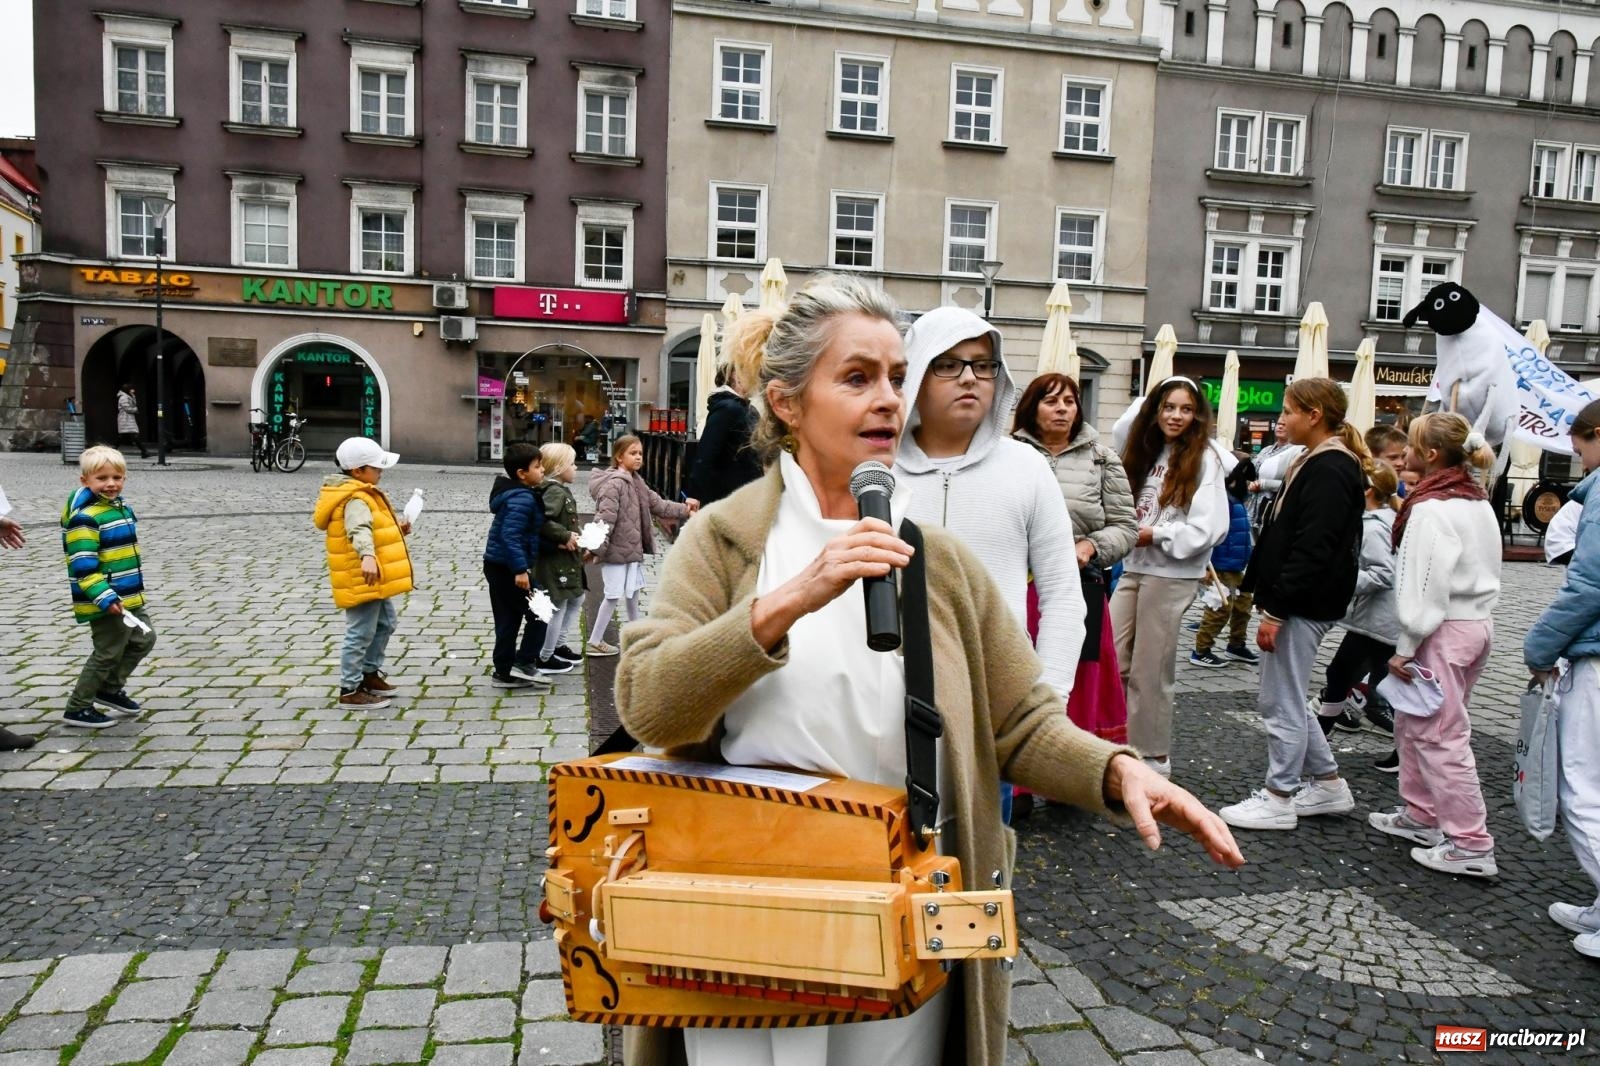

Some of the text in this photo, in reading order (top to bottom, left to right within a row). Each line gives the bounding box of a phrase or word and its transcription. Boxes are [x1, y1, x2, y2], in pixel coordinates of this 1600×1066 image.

[80, 268, 192, 287] TABAC
[242, 276, 394, 309] KANTOR
[296, 351, 351, 363] KANTOR
[364, 375, 374, 437] KANTOR
